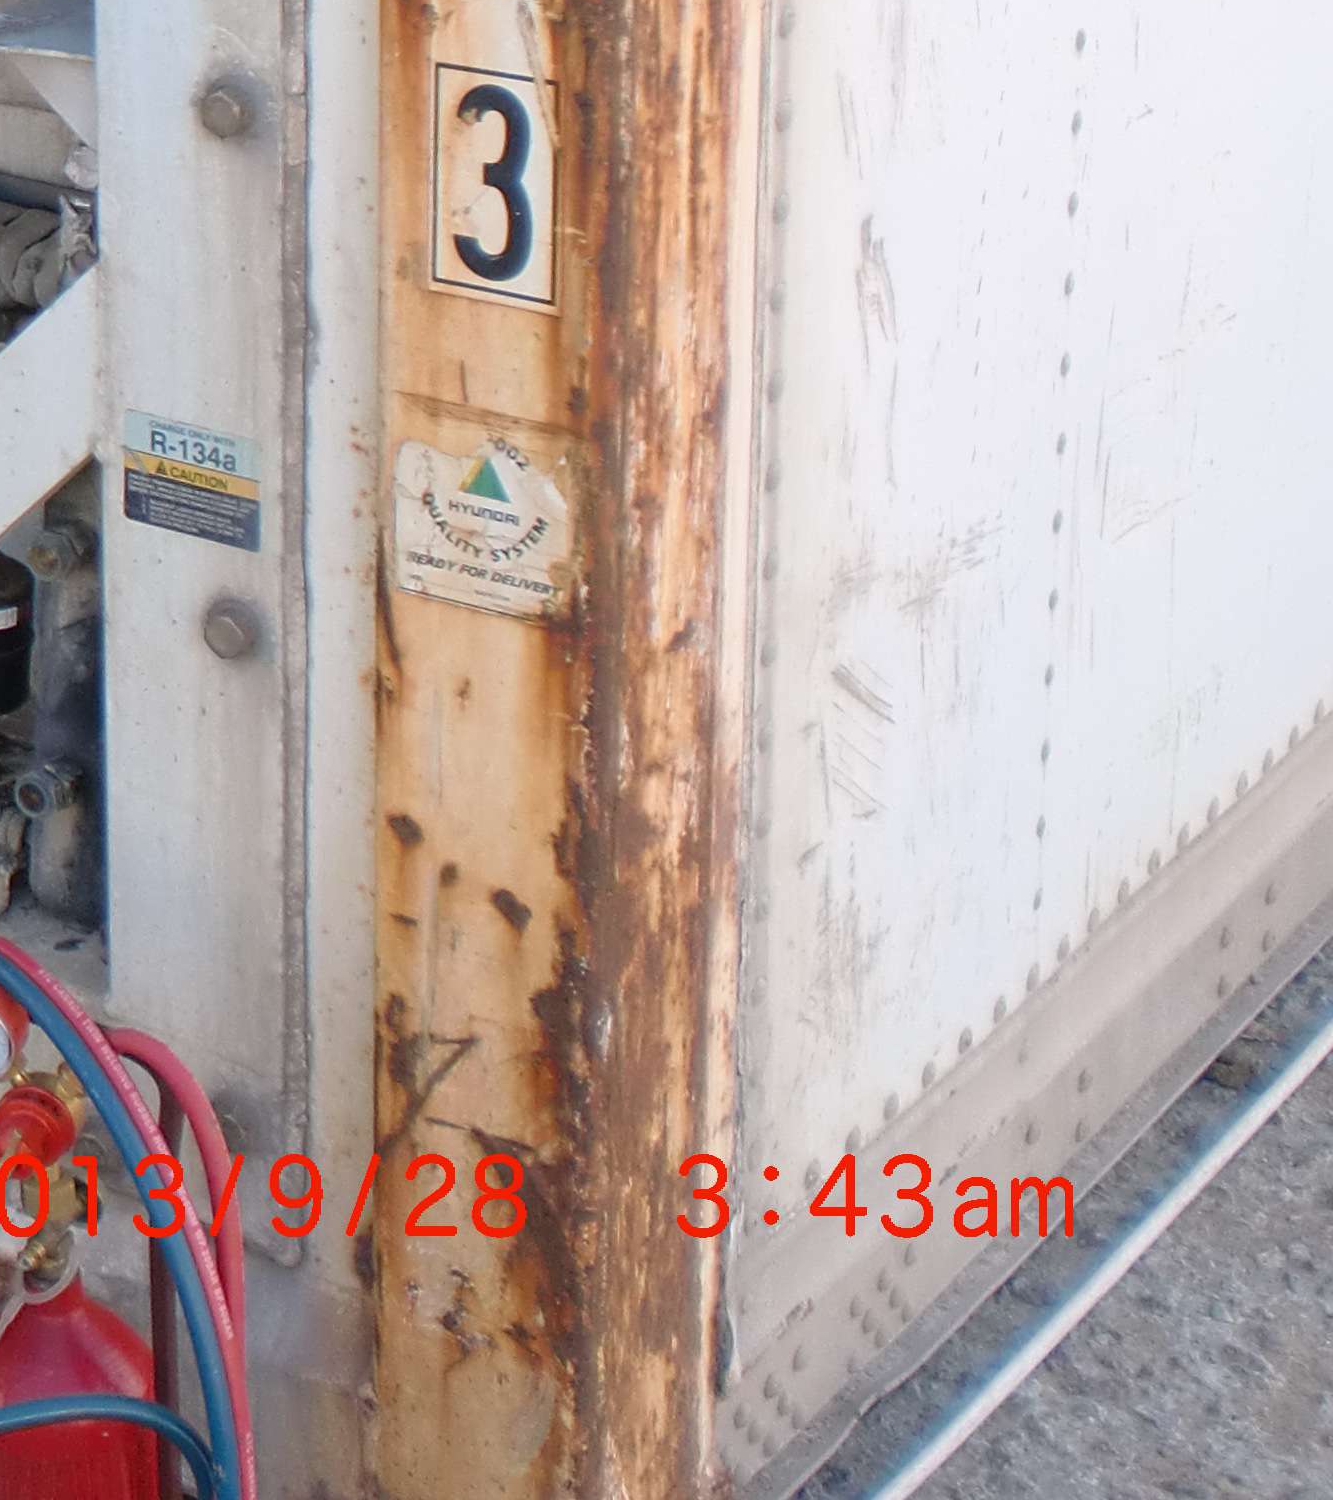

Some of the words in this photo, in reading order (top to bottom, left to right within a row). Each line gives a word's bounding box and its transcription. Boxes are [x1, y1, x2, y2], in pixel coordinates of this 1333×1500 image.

[453, 84, 532, 281] 3
[150, 429, 237, 472] R-134a
[169, 466, 229, 491] CAUTION
[422, 492, 483, 559] QUALITY
[490, 516, 550, 562] SYSTEM
[447, 500, 520, 526] HYUNDAI
[407, 551, 460, 572] READY
[458, 564, 488, 579] FOR
